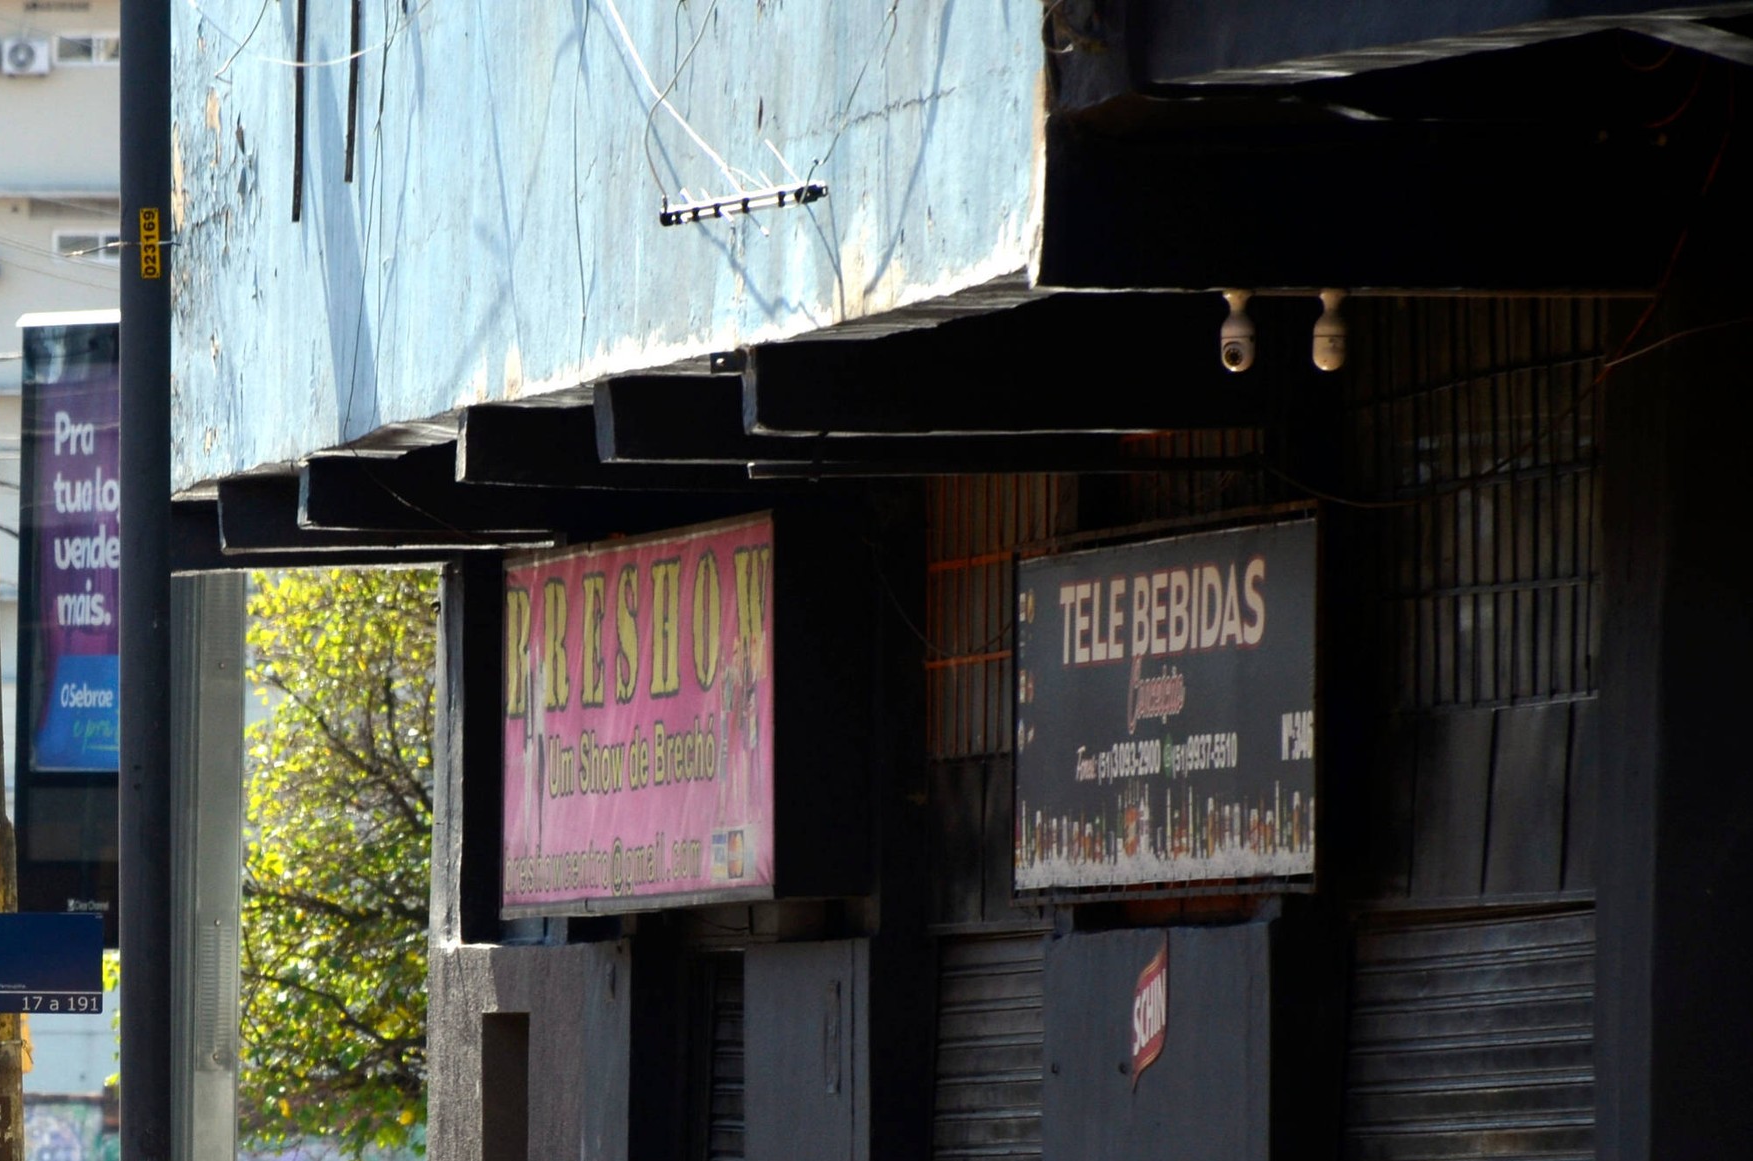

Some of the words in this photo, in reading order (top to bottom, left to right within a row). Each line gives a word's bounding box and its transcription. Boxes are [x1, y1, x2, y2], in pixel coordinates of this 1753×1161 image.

[143, 210, 157, 276] 023169
[54, 411, 94, 456] Pra
[94, 467, 120, 522] lo
[57, 578, 111, 627] mais.
[505, 547, 771, 719] BRESHOW
[1059, 578, 1126, 665] TELE
[1131, 557, 1266, 656] BEBIDAS
[548, 735, 574, 798] Um
[579, 729, 624, 796] Show
[629, 725, 649, 791] de
[653, 713, 716, 786] Brechó
[22, 996, 43, 1011] 17
[49, 999, 59, 1011] a
[67, 996, 99, 1011] 191
[1133, 968, 1166, 1056] SCHIN
